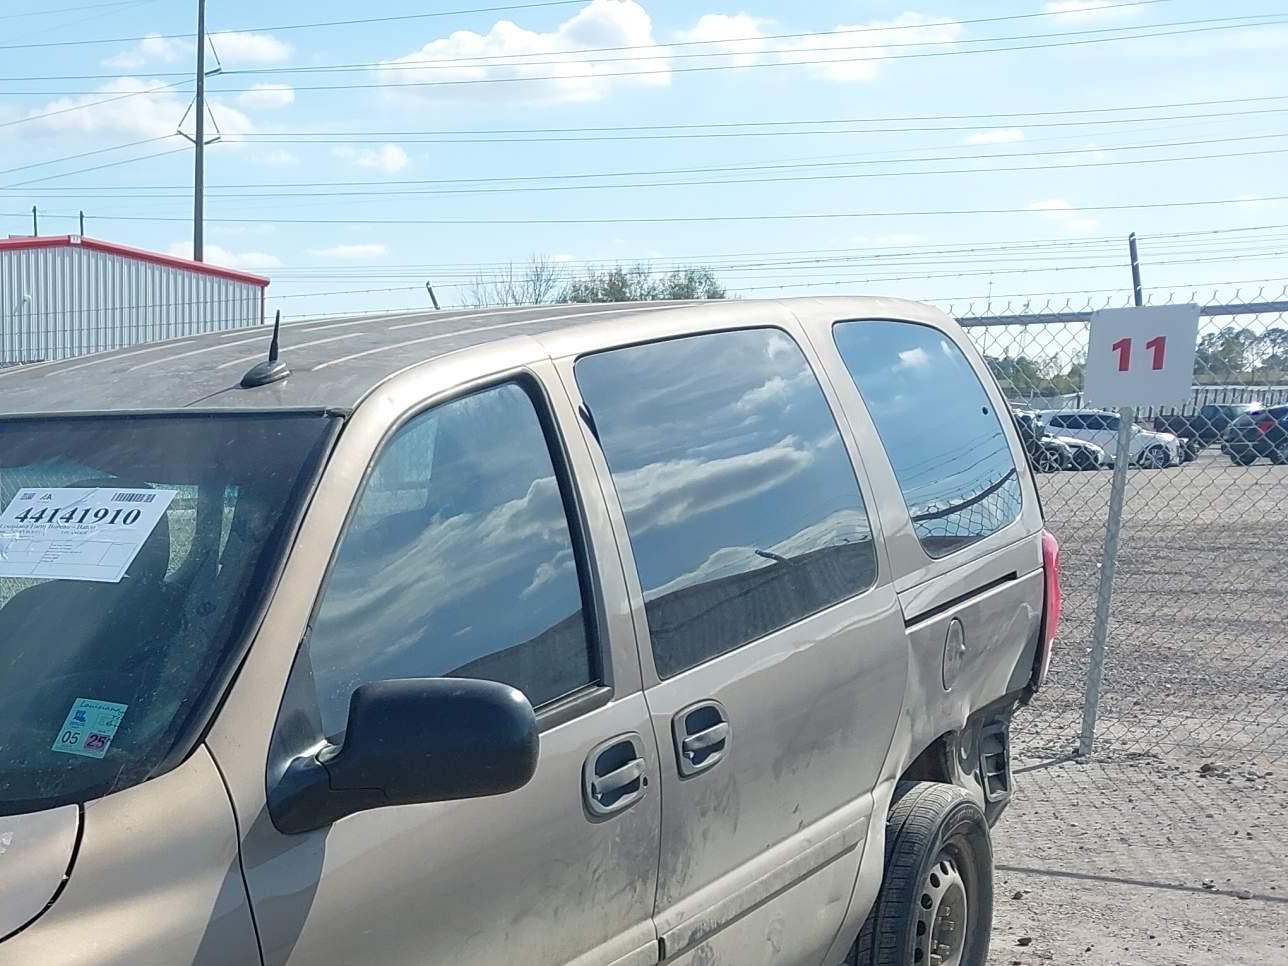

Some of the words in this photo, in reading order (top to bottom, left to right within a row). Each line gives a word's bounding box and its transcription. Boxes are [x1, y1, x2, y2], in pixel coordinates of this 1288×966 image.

[1111, 336, 1167, 372] 11
[14, 507, 142, 525] 44141910
[61, 731, 81, 745] 05
[87, 734, 107, 748] 25
